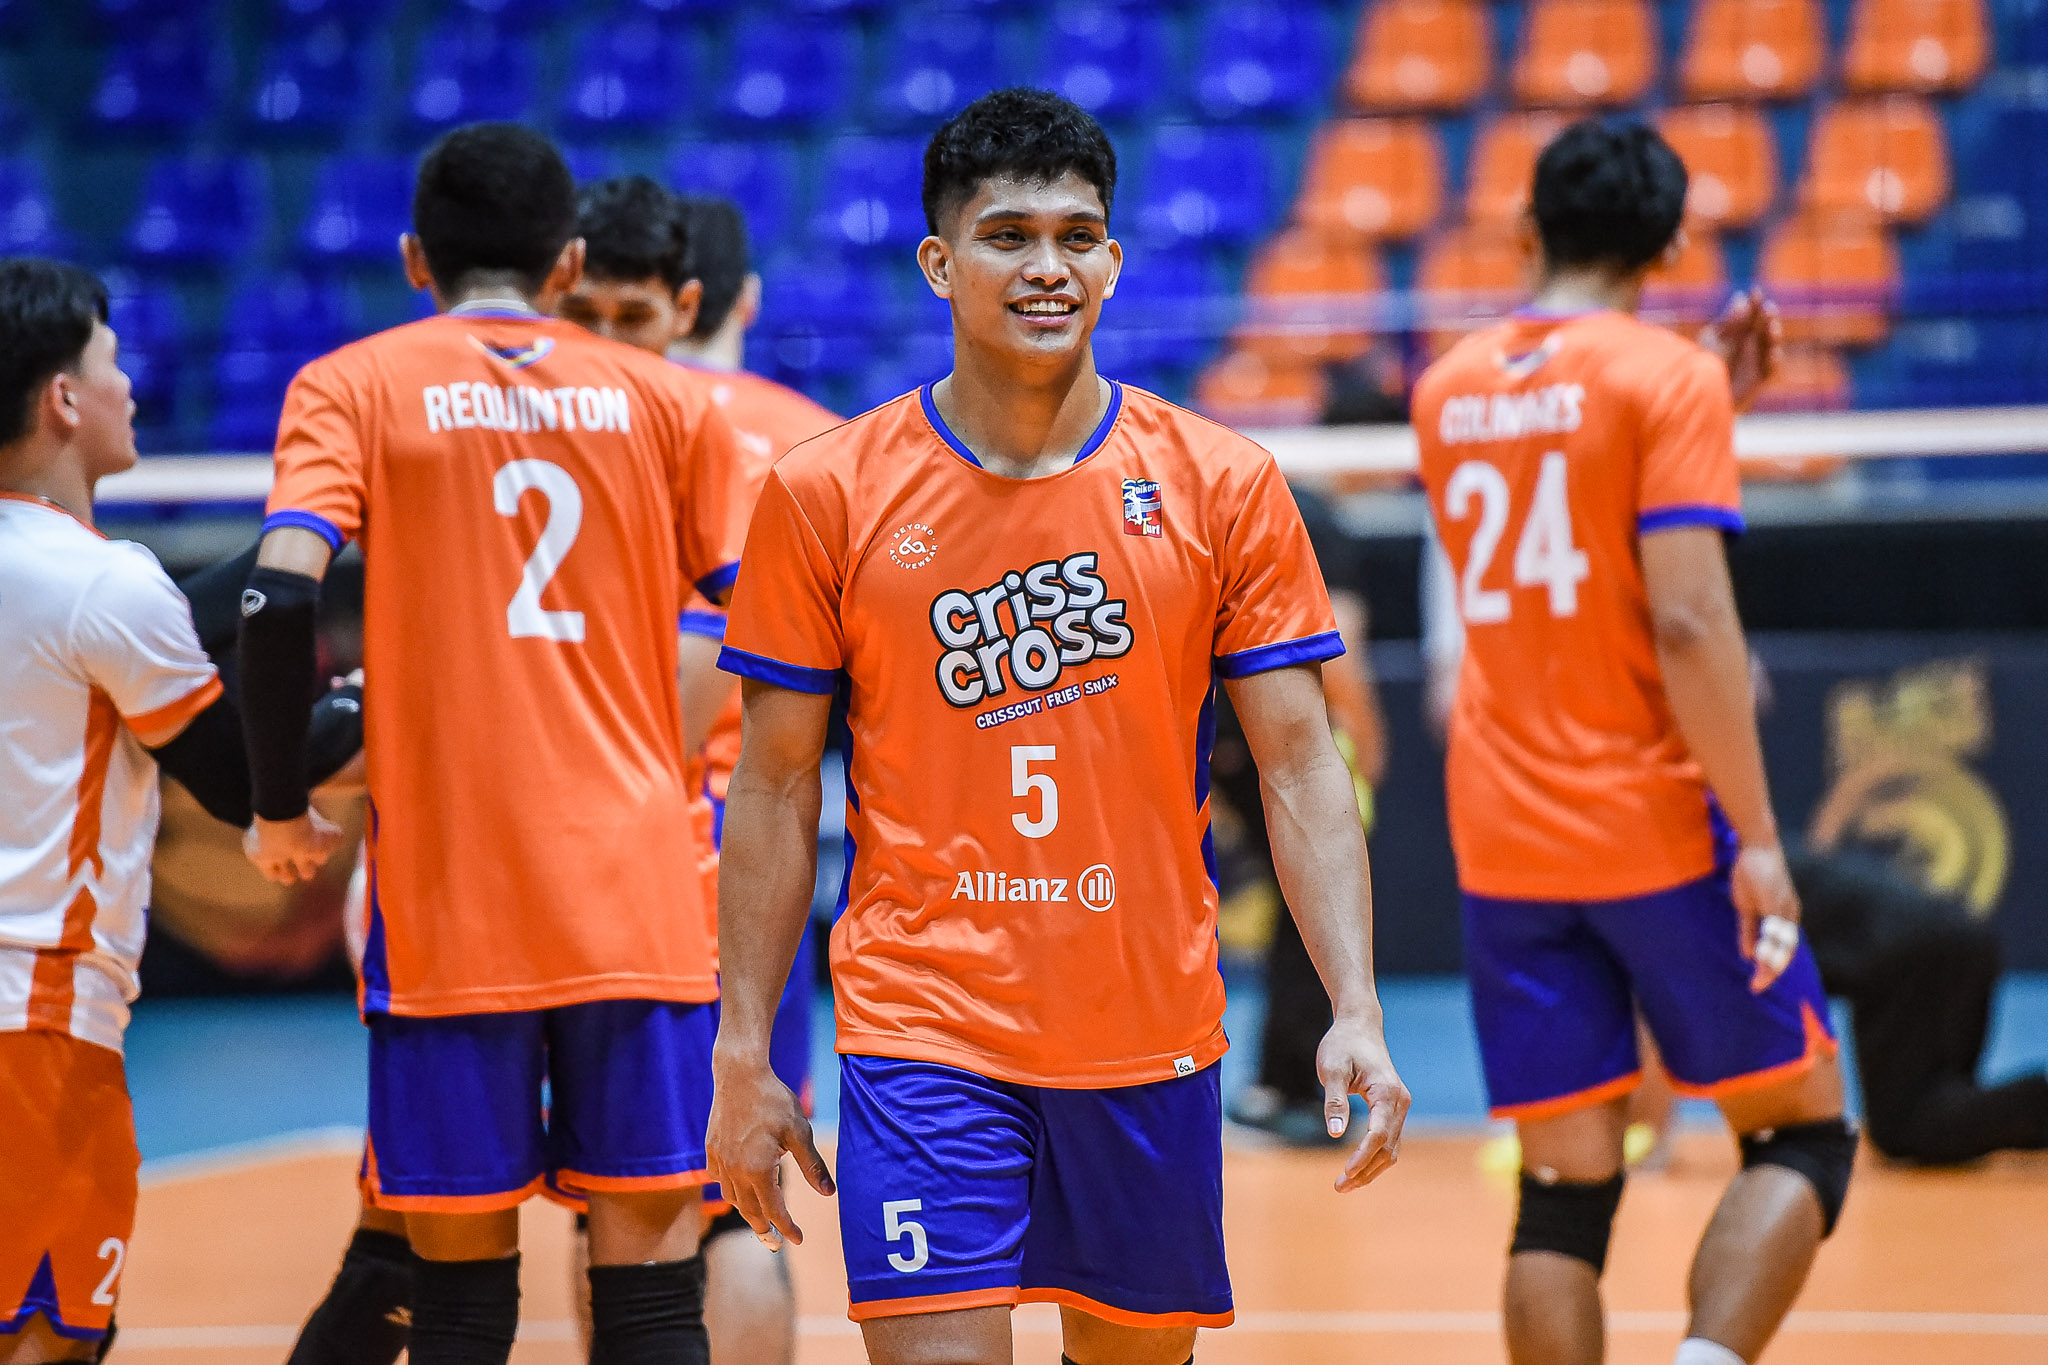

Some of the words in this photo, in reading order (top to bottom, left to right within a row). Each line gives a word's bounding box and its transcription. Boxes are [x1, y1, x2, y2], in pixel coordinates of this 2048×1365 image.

[422, 383, 631, 433] REQUINTON
[1121, 478, 1161, 500] Spikers
[494, 458, 585, 642] 2
[893, 523, 934, 539] BEYOND
[1142, 516, 1161, 535] Turf
[1446, 452, 1589, 622] 24
[889, 544, 938, 569] ACTIVEWEAR
[930, 553, 1106, 649] criss
[936, 600, 1133, 707] cross
[976, 698, 1042, 729] CRISSCUT
[1047, 685, 1081, 708] FRIES
[1085, 675, 1119, 696] SNAX
[1010, 745, 1059, 838] 5
[950, 870, 1069, 902] Allianz
[882, 1198, 929, 1273] 5
[91, 1237, 125, 1305] 2
